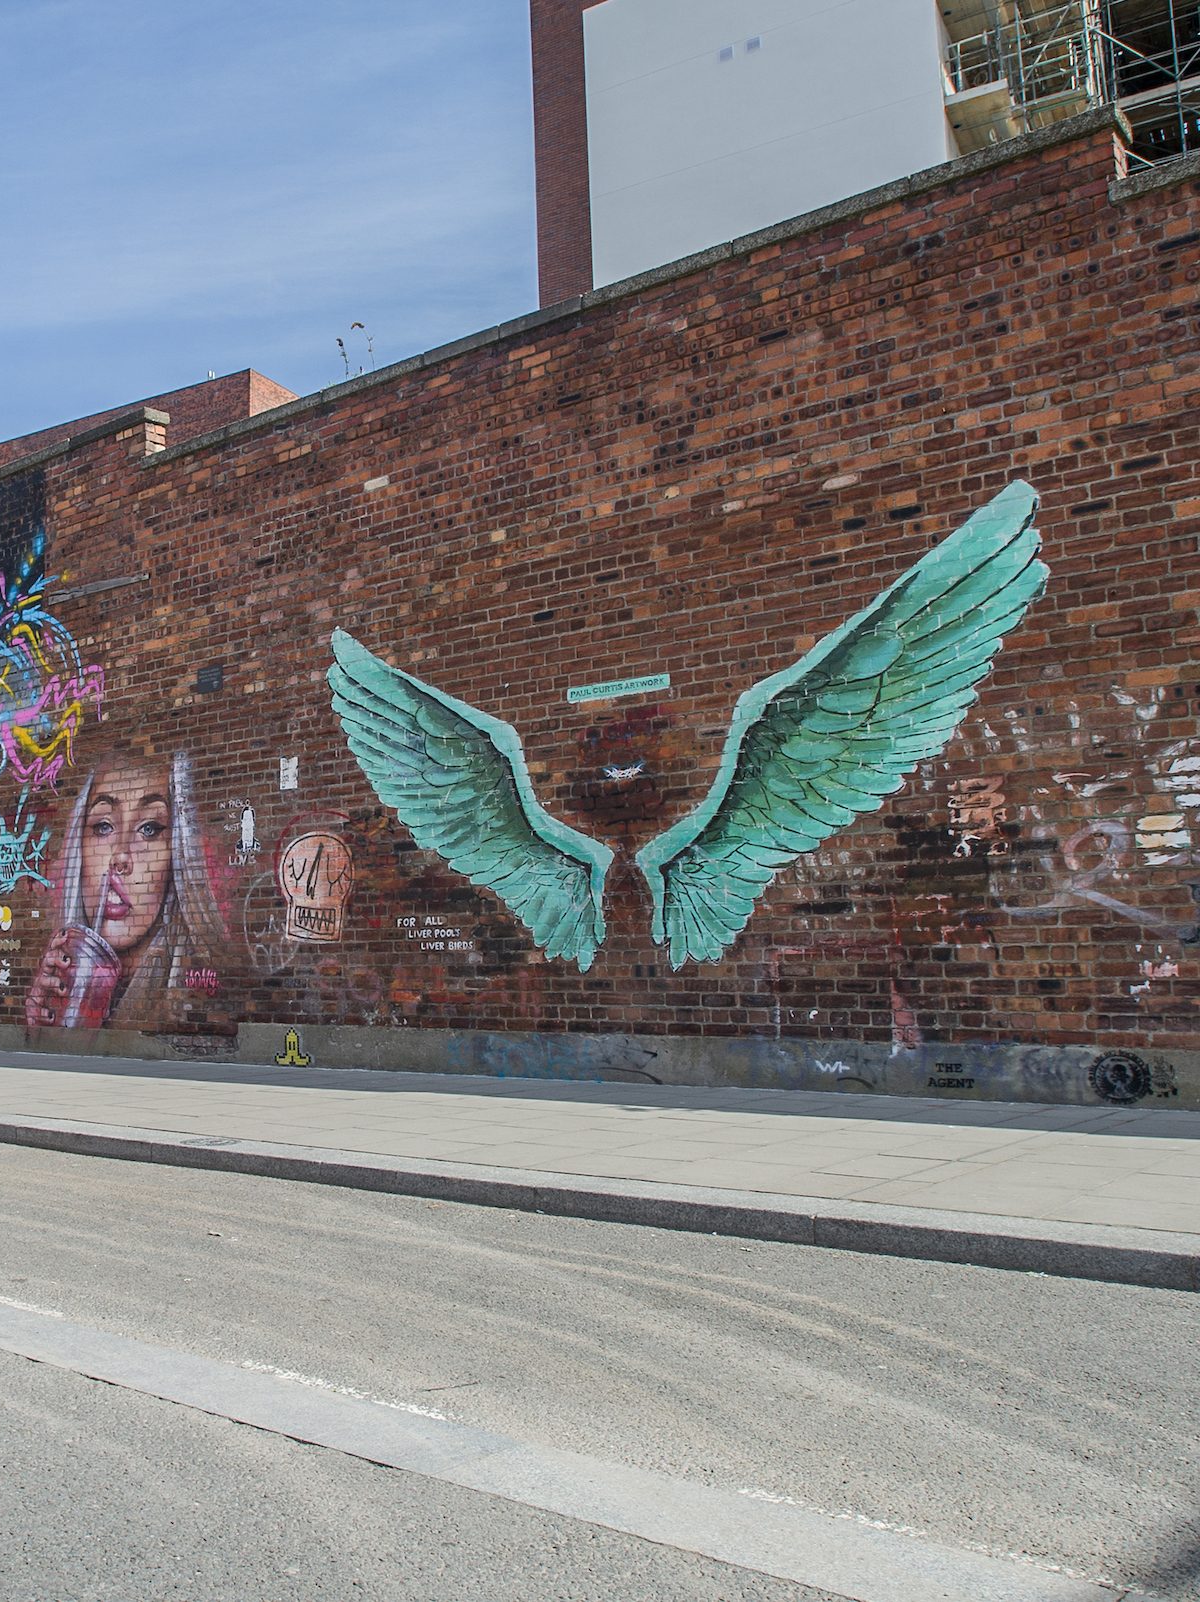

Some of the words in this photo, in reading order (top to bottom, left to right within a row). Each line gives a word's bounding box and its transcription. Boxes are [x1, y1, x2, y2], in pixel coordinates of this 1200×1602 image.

[570, 688, 591, 698] PAUL
[592, 683, 623, 694] CURTIS
[624, 677, 665, 690] ARTWORK
[397, 917, 416, 927] FOR
[425, 916, 443, 925] ALL
[420, 941, 445, 950] LIVER
[448, 941, 473, 950] BIRDS
[935, 1063, 963, 1073] THE
[927, 1077, 975, 1088] AGENT
